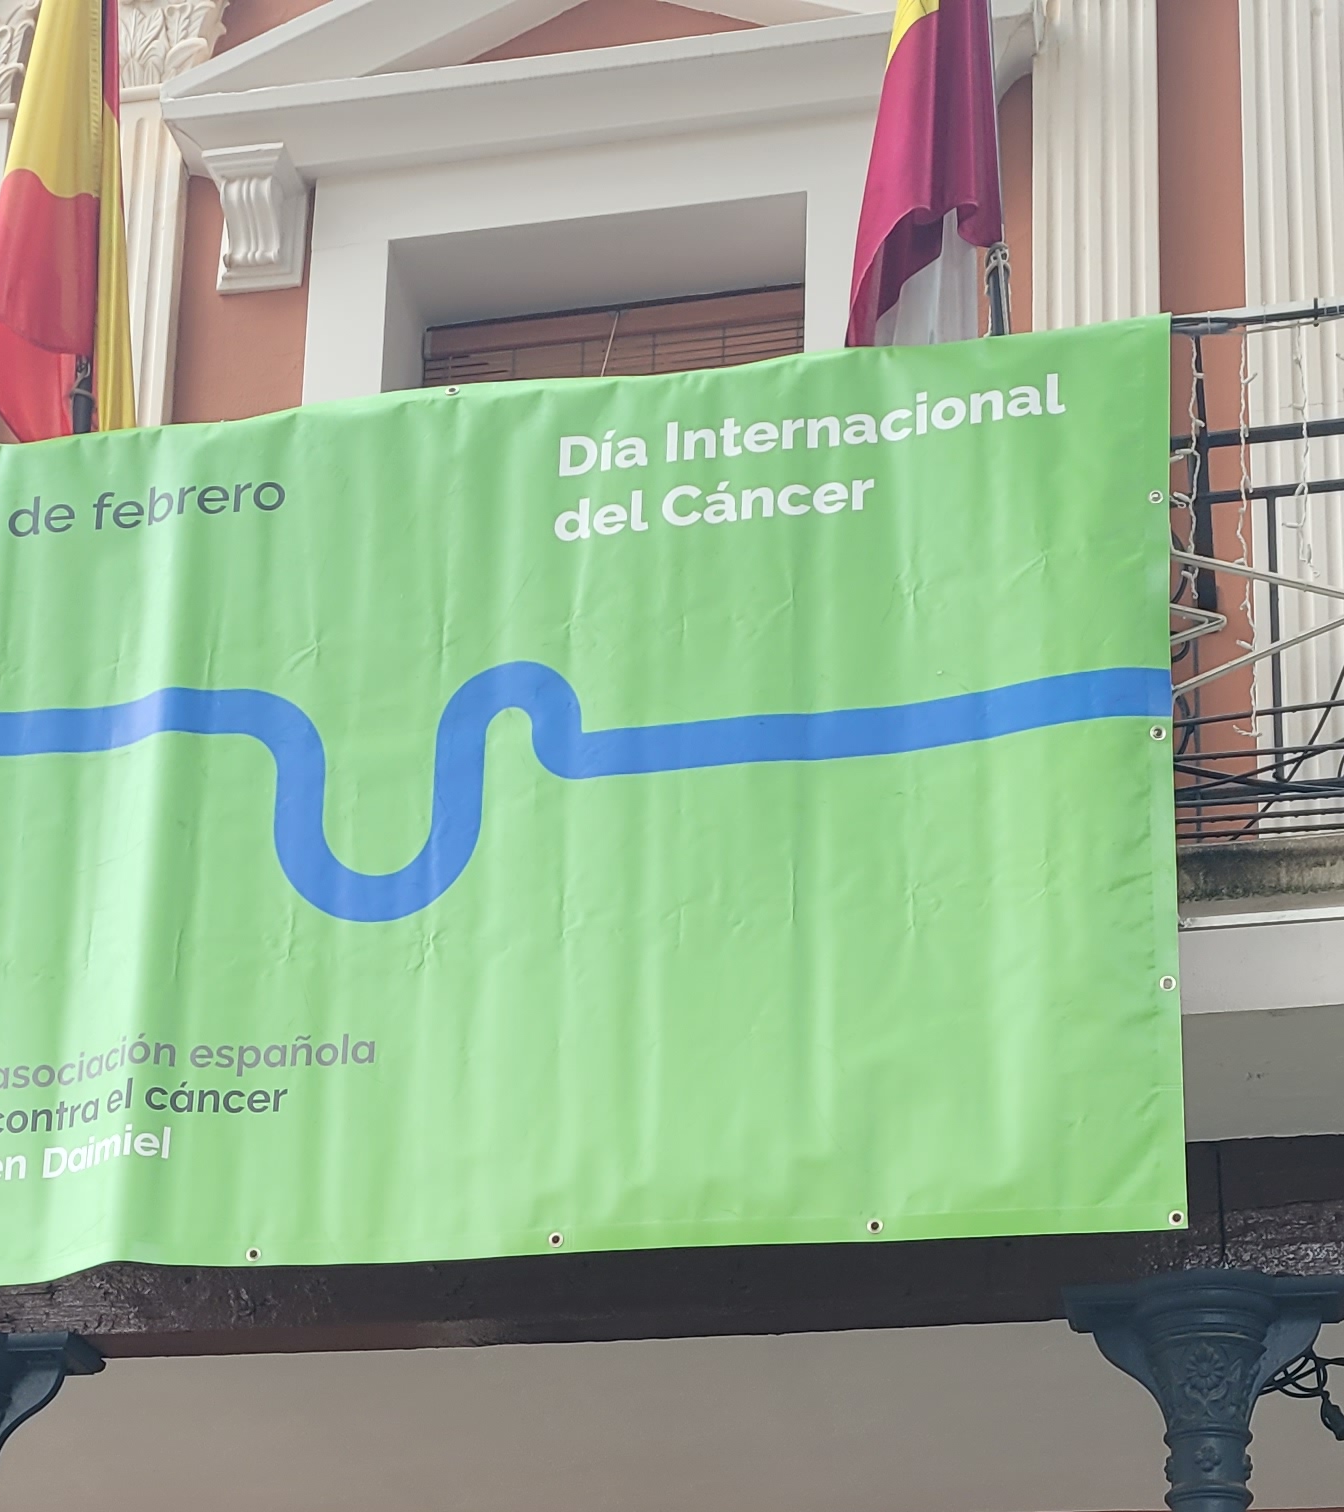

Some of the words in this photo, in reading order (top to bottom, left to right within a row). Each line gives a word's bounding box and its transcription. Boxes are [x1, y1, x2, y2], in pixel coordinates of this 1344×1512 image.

[558, 429, 648, 477] Día
[665, 373, 1066, 462] Internacional
[8, 495, 75, 538] de
[92, 480, 286, 530] febrero
[554, 489, 649, 541] del
[661, 478, 875, 527] Cáncer
[189, 1033, 376, 1077] española
[106, 1077, 134, 1112] el
[143, 1081, 289, 1115] cáncer
[42, 1126, 172, 1180] Daimiel
